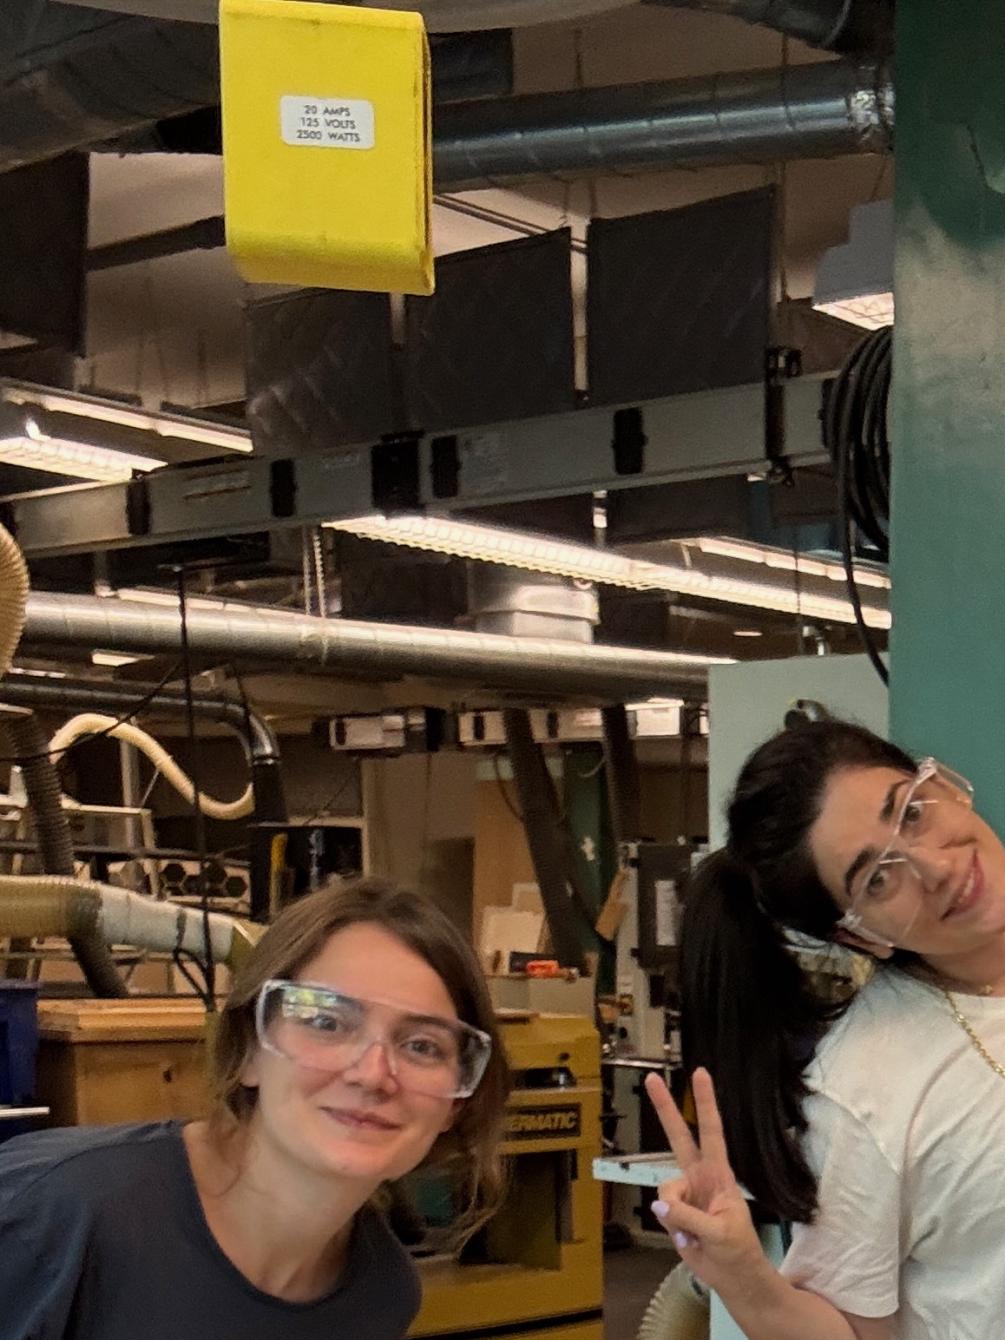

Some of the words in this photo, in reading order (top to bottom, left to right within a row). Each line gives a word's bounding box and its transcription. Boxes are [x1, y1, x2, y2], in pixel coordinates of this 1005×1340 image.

[303, 104, 318, 115] 20
[322, 106, 351, 117] AMPS
[300, 116, 320, 128] 125
[324, 118, 357, 130] VOLTS
[296, 129, 322, 140] 2500
[327, 132, 361, 143] WATTS
